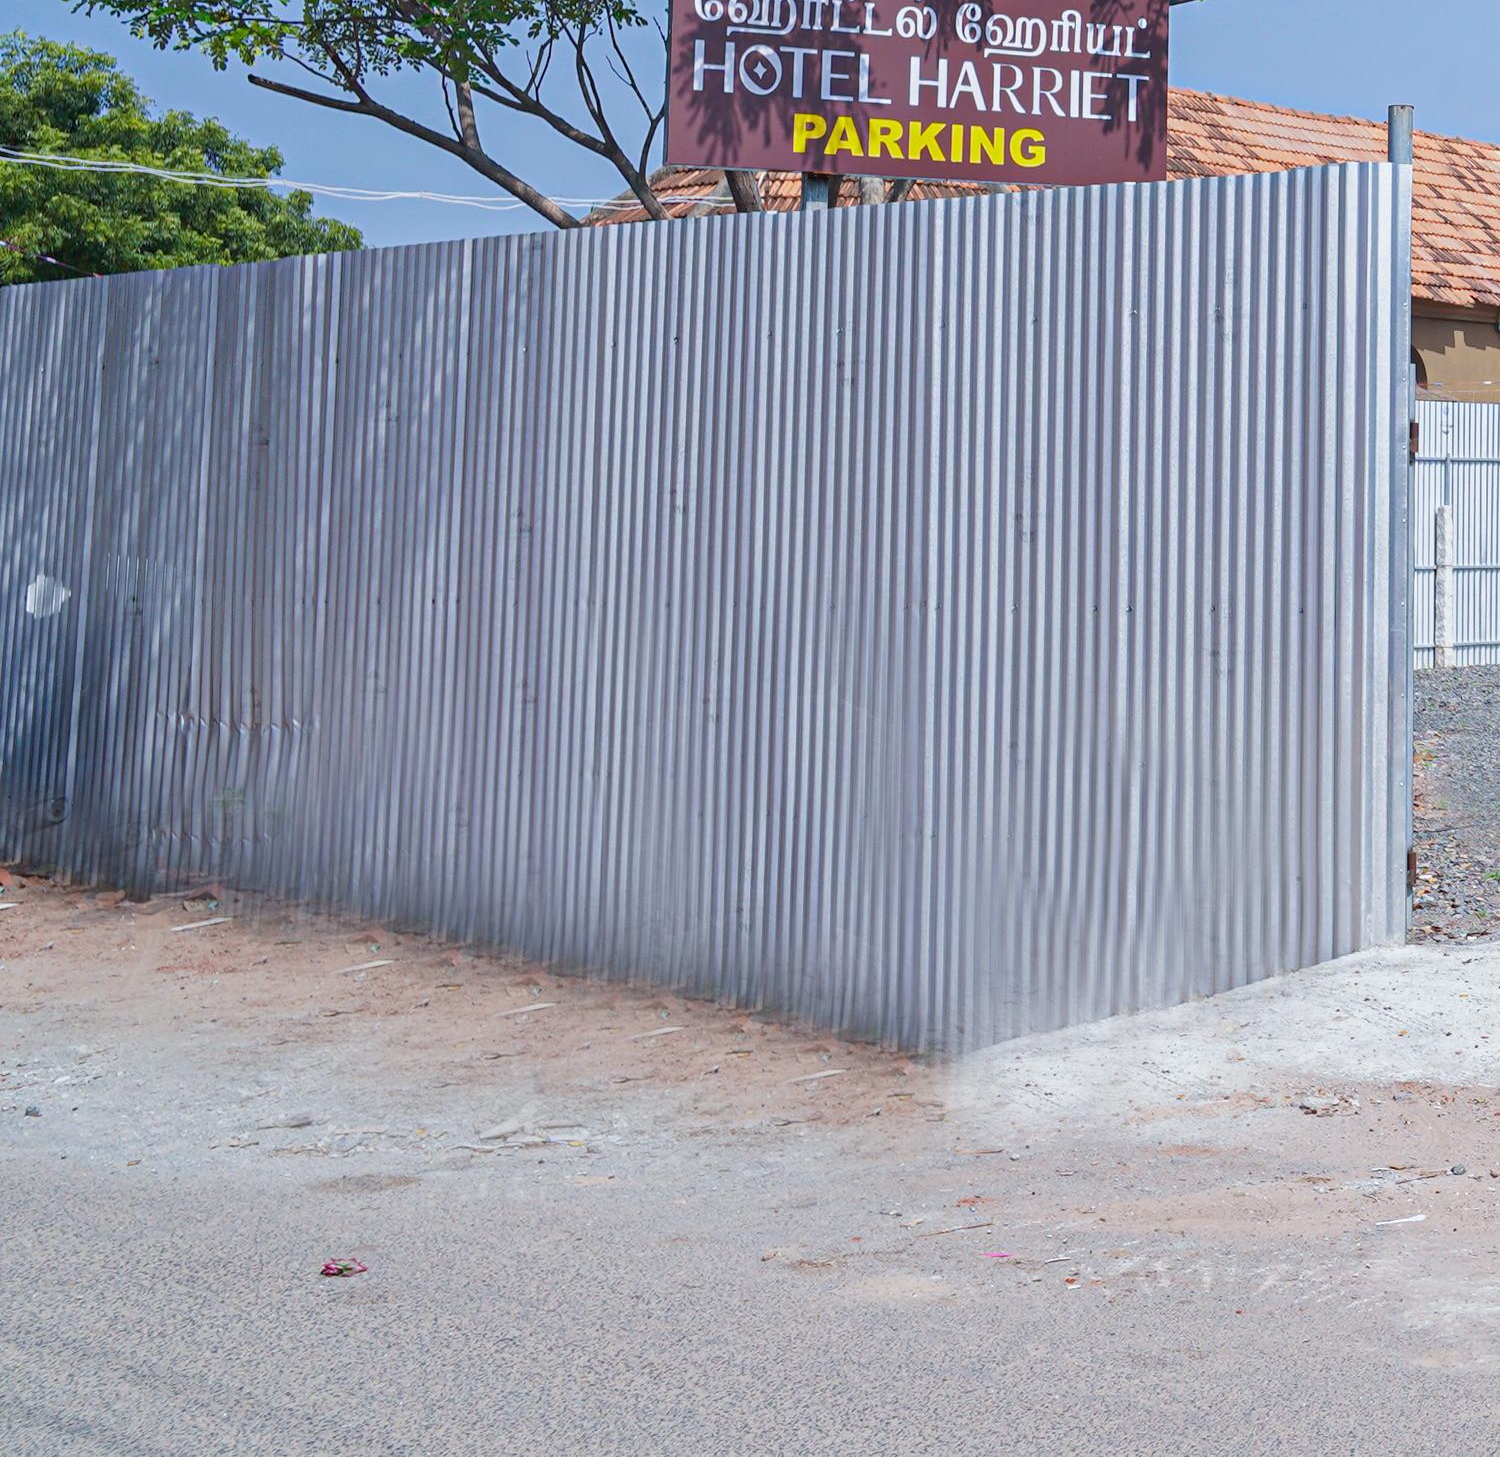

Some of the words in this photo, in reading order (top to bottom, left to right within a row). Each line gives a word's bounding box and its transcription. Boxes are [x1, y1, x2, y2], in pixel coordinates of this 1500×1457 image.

[955, 3, 1151, 59] ஹேரியட்
[693, 38, 893, 106] HOTEL
[908, 55, 1151, 123] HARRIET
[791, 112, 1047, 169] PARKING
